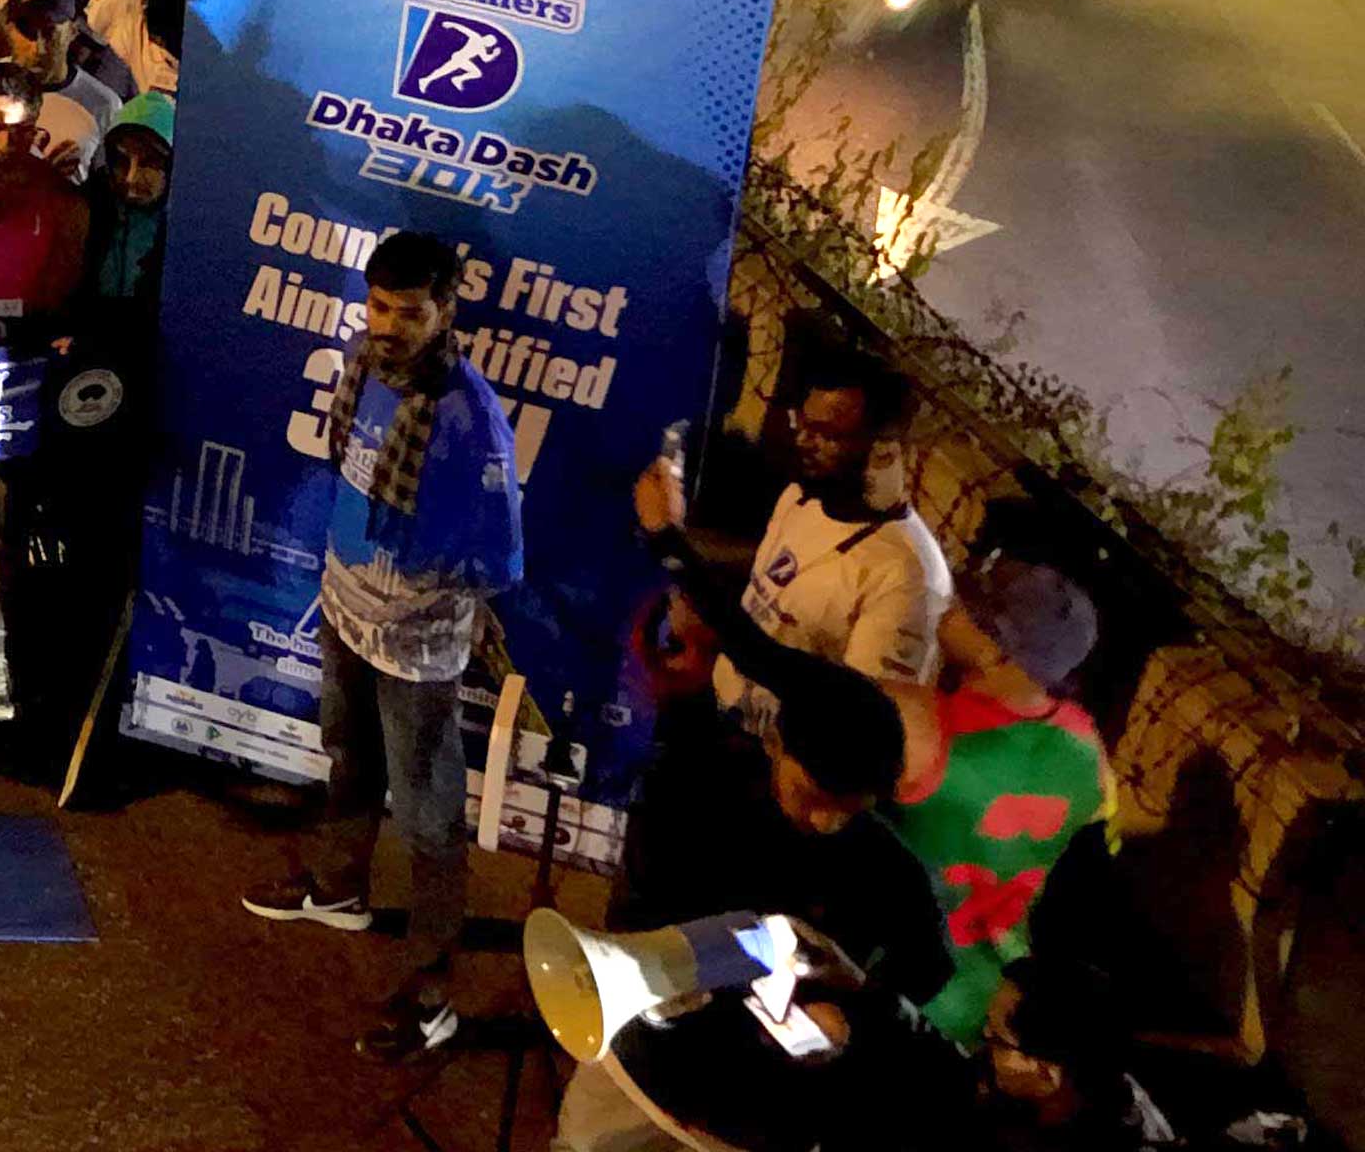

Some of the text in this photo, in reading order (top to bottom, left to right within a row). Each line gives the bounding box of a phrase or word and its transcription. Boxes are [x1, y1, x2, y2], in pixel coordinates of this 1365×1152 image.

[311, 94, 595, 191] Dhaka Dash
[361, 146, 527, 213] 30K
[243, 264, 369, 342] Aims
[498, 256, 628, 338] First
